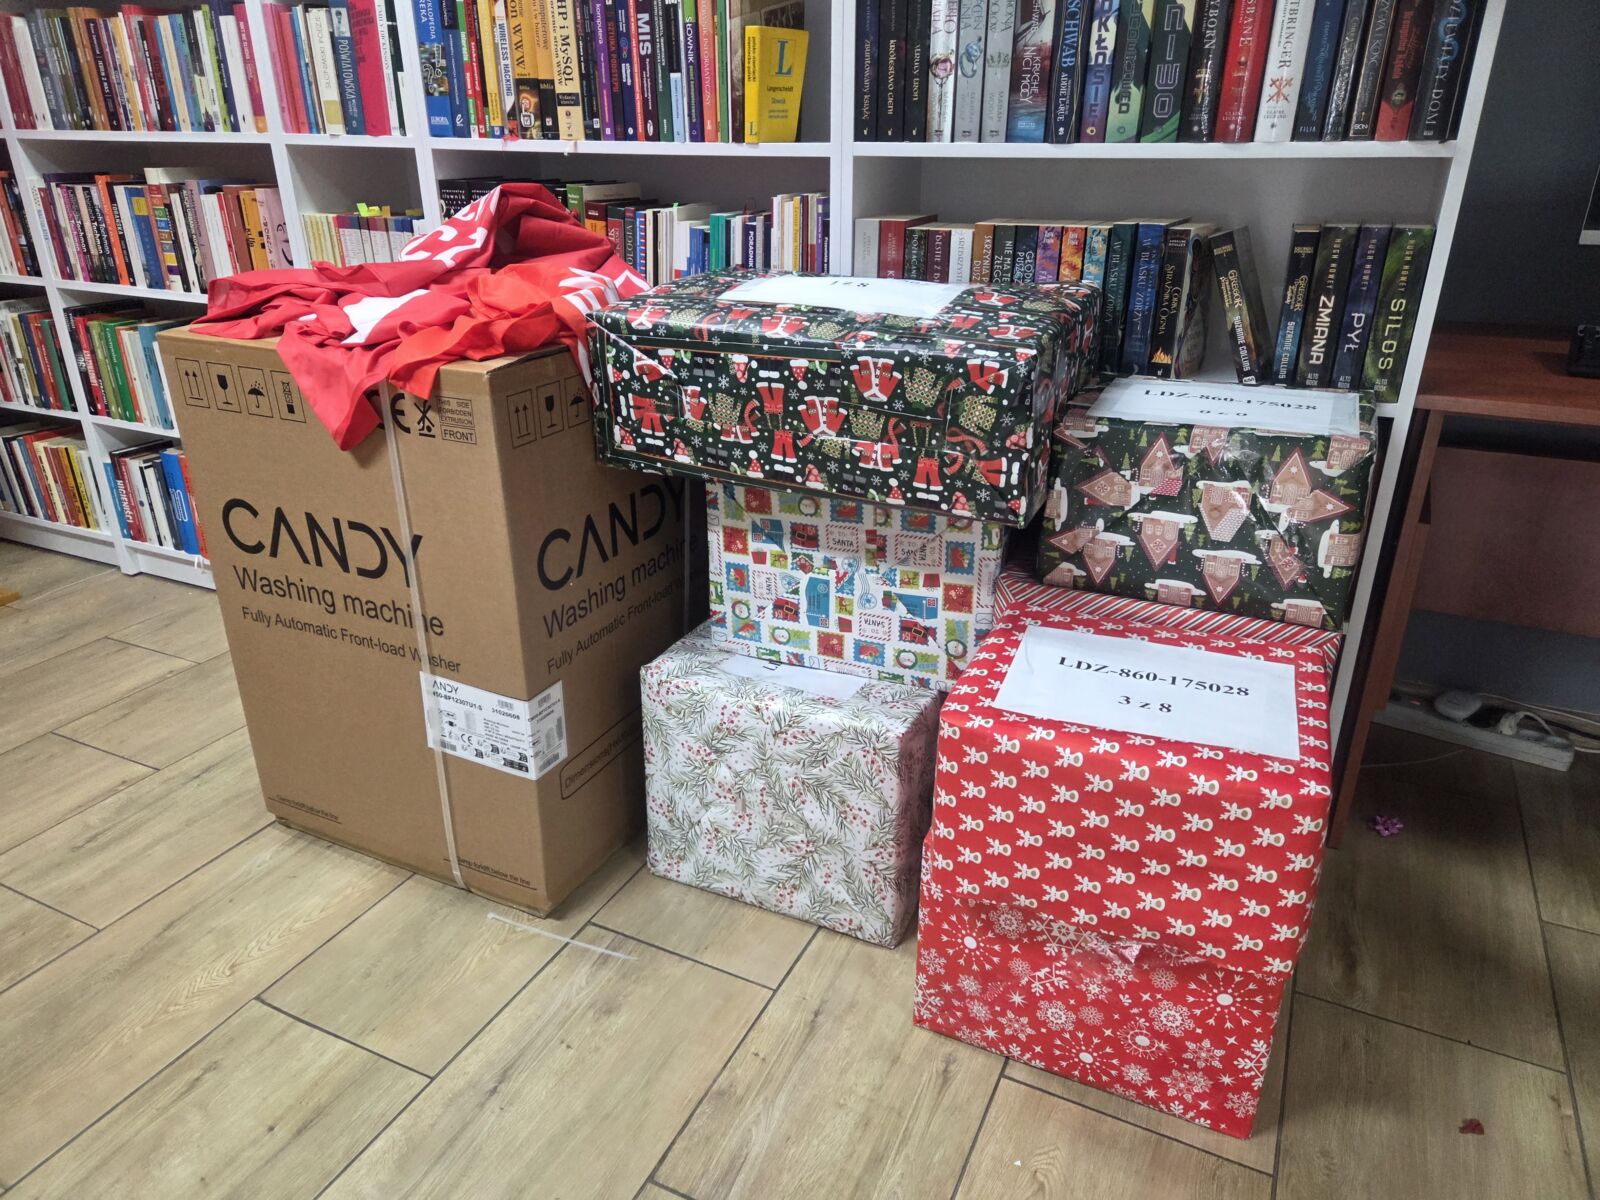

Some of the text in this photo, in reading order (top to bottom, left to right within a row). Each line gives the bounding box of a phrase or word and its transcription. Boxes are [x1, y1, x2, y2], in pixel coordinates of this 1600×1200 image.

[596, 3, 604, 45] komputera
[636, 12, 652, 56] MIS
[685, 16, 695, 63] SŁOWNIK
[1062, 0, 1081, 68] SCHWAB
[498, 22, 514, 97] WIRELESS HACKING
[512, 24, 526, 70] WWW
[560, 34, 574, 86] MySQL
[774, 40, 792, 76] L
[1022, 46, 1037, 70] NICI
[338, 39, 356, 100] POŚWIATOWSKA
[1030, 56, 1041, 94] KRUCHE
[1060, 72, 1068, 97] ADDIE
[1425, 90, 1444, 125] DOM
[92, 220, 102, 254] Tochman
[983, 235, 992, 274] SKRZYNIA
[1002, 240, 1013, 268] NIE MA
[972, 260, 982, 282] DUSZ
[1326, 238, 1343, 290] HUGH HOWEY
[1360, 238, 1377, 292] HUGH HOWEY
[1398, 238, 1416, 292] HUGH HOWEY
[1170, 286, 1182, 314] CÓRKA
[1228, 270, 1243, 309] GREGOR
[1158, 308, 1170, 336] OGNIA
[1308, 295, 1335, 366] ZMIANA
[1344, 312, 1365, 354] PYŁ
[1378, 298, 1406, 370] SILOS
[1232, 315, 1246, 344] SUZANNE
[1239, 344, 1251, 372] COLLINS
[1278, 322, 1296, 380] SUZANNE COLLINS
[456, 401, 470, 409] SIDE
[1144, 389, 1318, 410] LDZ-860-175028
[444, 429, 474, 442] FRONT
[116, 479, 133, 524] HIGIENIŚCI
[222, 498, 423, 588] CANDY
[537, 474, 686, 590] CANDY
[832, 539, 854, 548] SANTA
[232, 564, 336, 615] Washing
[543, 575, 626, 640] Washing
[242, 606, 272, 628] Fully
[275, 614, 338, 640] Automatic
[340, 628, 406, 658] Front-load
[864, 618, 886, 629] SANTA
[546, 648, 574, 676] Fully
[576, 614, 626, 658] Automatic
[432, 680, 460, 694] ANDY
[1058, 656, 1250, 697] LDZ-860-175028
[1118, 696, 1172, 714] 3 z 8
